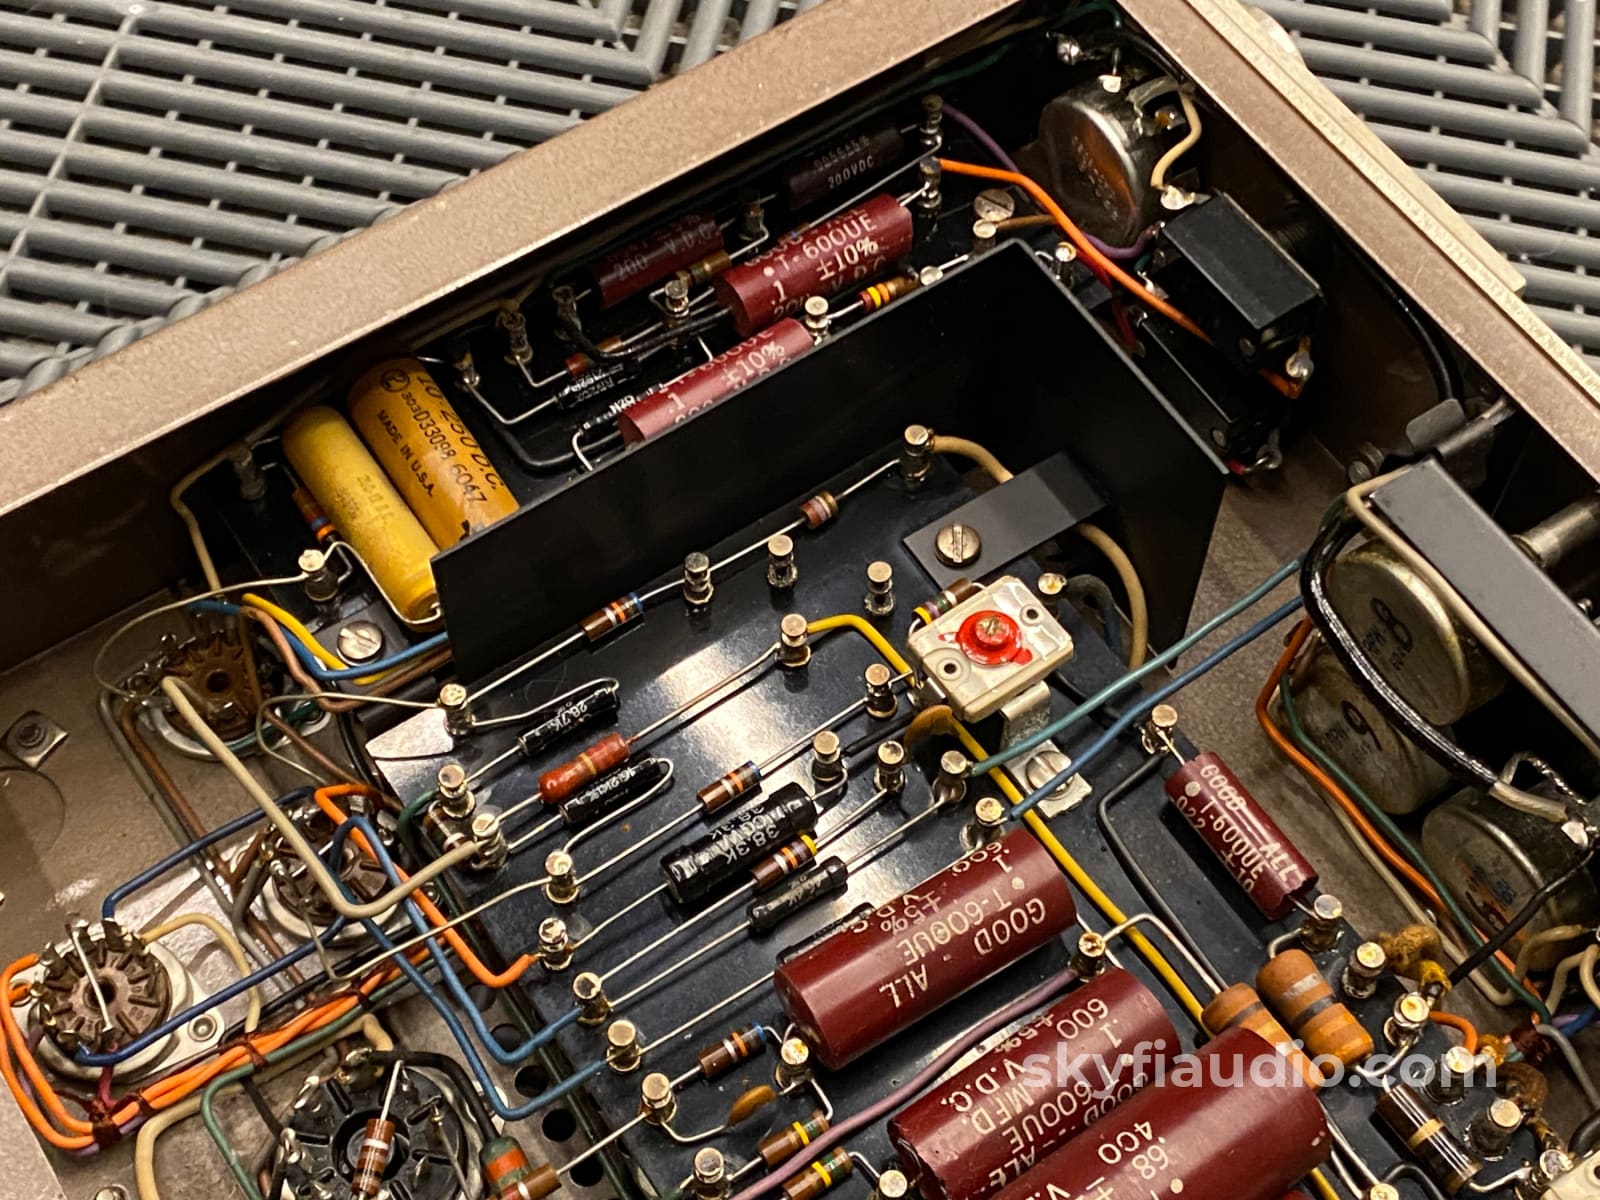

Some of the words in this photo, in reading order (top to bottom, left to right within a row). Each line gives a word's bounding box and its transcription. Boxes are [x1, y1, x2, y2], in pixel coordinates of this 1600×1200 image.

[815, 236, 879, 282] ±10%
[376, 409, 403, 446] MADE
[400, 444, 413, 463] IN
[1369, 597, 1415, 652] 8
[724, 825, 781, 865] 38.3K
[1200, 763, 1247, 812] GOOD
[1258, 841, 1299, 882] ALL
[879, 889, 943, 936] ±5%
[895, 888, 1013, 967] T-600UE
[972, 897, 1047, 956] GOOD
[878, 963, 930, 1008] ALL
[1054, 997, 1110, 1041] 600
